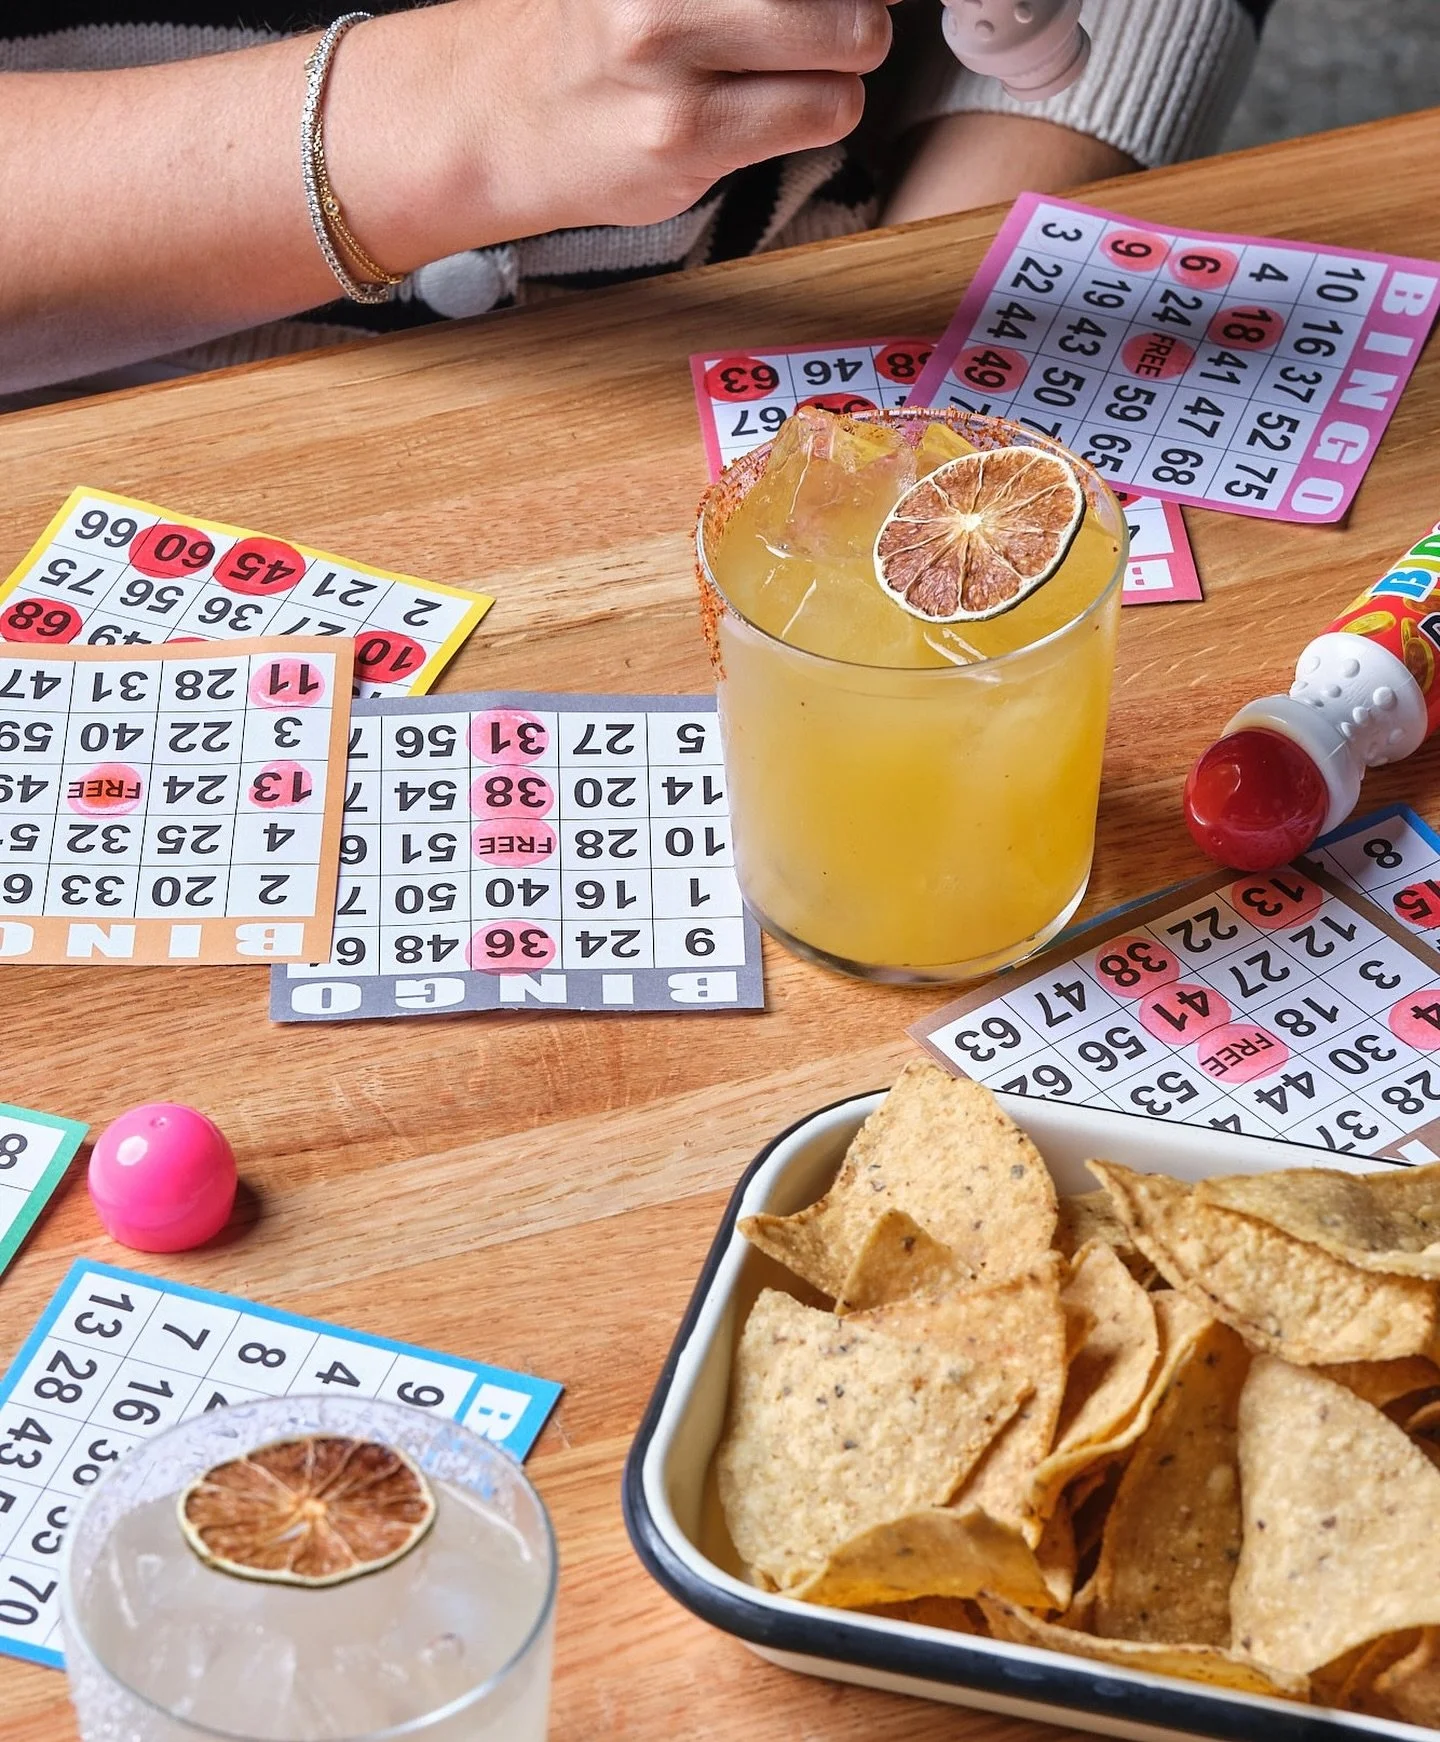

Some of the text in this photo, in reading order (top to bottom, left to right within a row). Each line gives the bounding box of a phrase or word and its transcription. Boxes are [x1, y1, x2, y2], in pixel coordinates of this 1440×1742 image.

[1041, 221, 1084, 244] 3
[1110, 240, 1152, 260] 9
[1011, 256, 1063, 296] 22
[1081, 278, 1134, 310] 19
[987, 302, 1038, 340] 44
[1057, 315, 1109, 357] 43
[720, 365, 780, 393] 63
[803, 358, 863, 385] 46
[962, 352, 1017, 388] 49
[1081, 254, 1222, 472] 6 24 FREE 59 65
[1152, 262, 1290, 485] 4 18 41 47 68
[1032, 365, 1085, 409] 50
[1225, 266, 1368, 502] 10 16 37 52 75
[731, 406, 787, 437] 67
[39, 558, 105, 594] 75
[74, 510, 443, 627] 2 21 45 60 66
[119, 580, 184, 614] 56
[8, 602, 72, 636] 68
[198, 597, 264, 632] 36
[356, 637, 414, 672] 10
[0, 662, 321, 702] 11 28 31 47
[80, 722, 144, 753] 40
[169, 720, 233, 752] 22
[273, 717, 303, 747] 3
[395, 725, 459, 758] 56
[490, 721, 546, 755] 31
[573, 724, 636, 755] 27
[676, 724, 707, 755] 5
[68, 780, 142, 799] FREE
[163, 774, 228, 805] 24
[253, 771, 313, 803] 13
[394, 781, 457, 812] 54
[484, 776, 549, 809] 38
[573, 777, 637, 809] 20
[662, 776, 725, 805] 14
[66, 825, 132, 855] 32
[157, 824, 223, 854] 25
[263, 823, 297, 852] 4
[401, 833, 458, 865] 51
[478, 836, 552, 856] FREE
[575, 829, 638, 860] 28
[665, 827, 726, 857] 10
[1363, 838, 1403, 869] 8
[61, 875, 125, 906] 33
[152, 875, 216, 907] 20
[258, 874, 291, 904] 2
[395, 883, 457, 914] 50
[485, 878, 551, 908] 40
[575, 879, 637, 910] 16
[689, 878, 711, 908] 1
[396, 935, 460, 965] 48
[485, 928, 550, 959] 36
[575, 928, 641, 960] 24
[685, 928, 715, 957] 9
[1289, 916, 1357, 958] 12
[953, 877, 1304, 1062] 13 22 38 47 63
[1229, 950, 1290, 999] 27
[1150, 984, 1211, 1033] 41
[1078, 1026, 1147, 1072] 56
[1130, 960, 1402, 1116] 3 18 FREE 53
[1328, 1034, 1397, 1075] 30
[1254, 1071, 1318, 1115] 44
[1316, 1069, 1440, 1151] 28 37
[75, 1292, 133, 1339] 13
[162, 1320, 211, 1351] 7
[238, 1342, 287, 1368] 8
[35, 1349, 97, 1404] 28
[315, 1360, 361, 1388] 4
[113, 1380, 174, 1425] 16
[397, 1381, 445, 1407] 9
[0, 1417, 53, 1469] 43
[0, 1575, 58, 1626] 70
